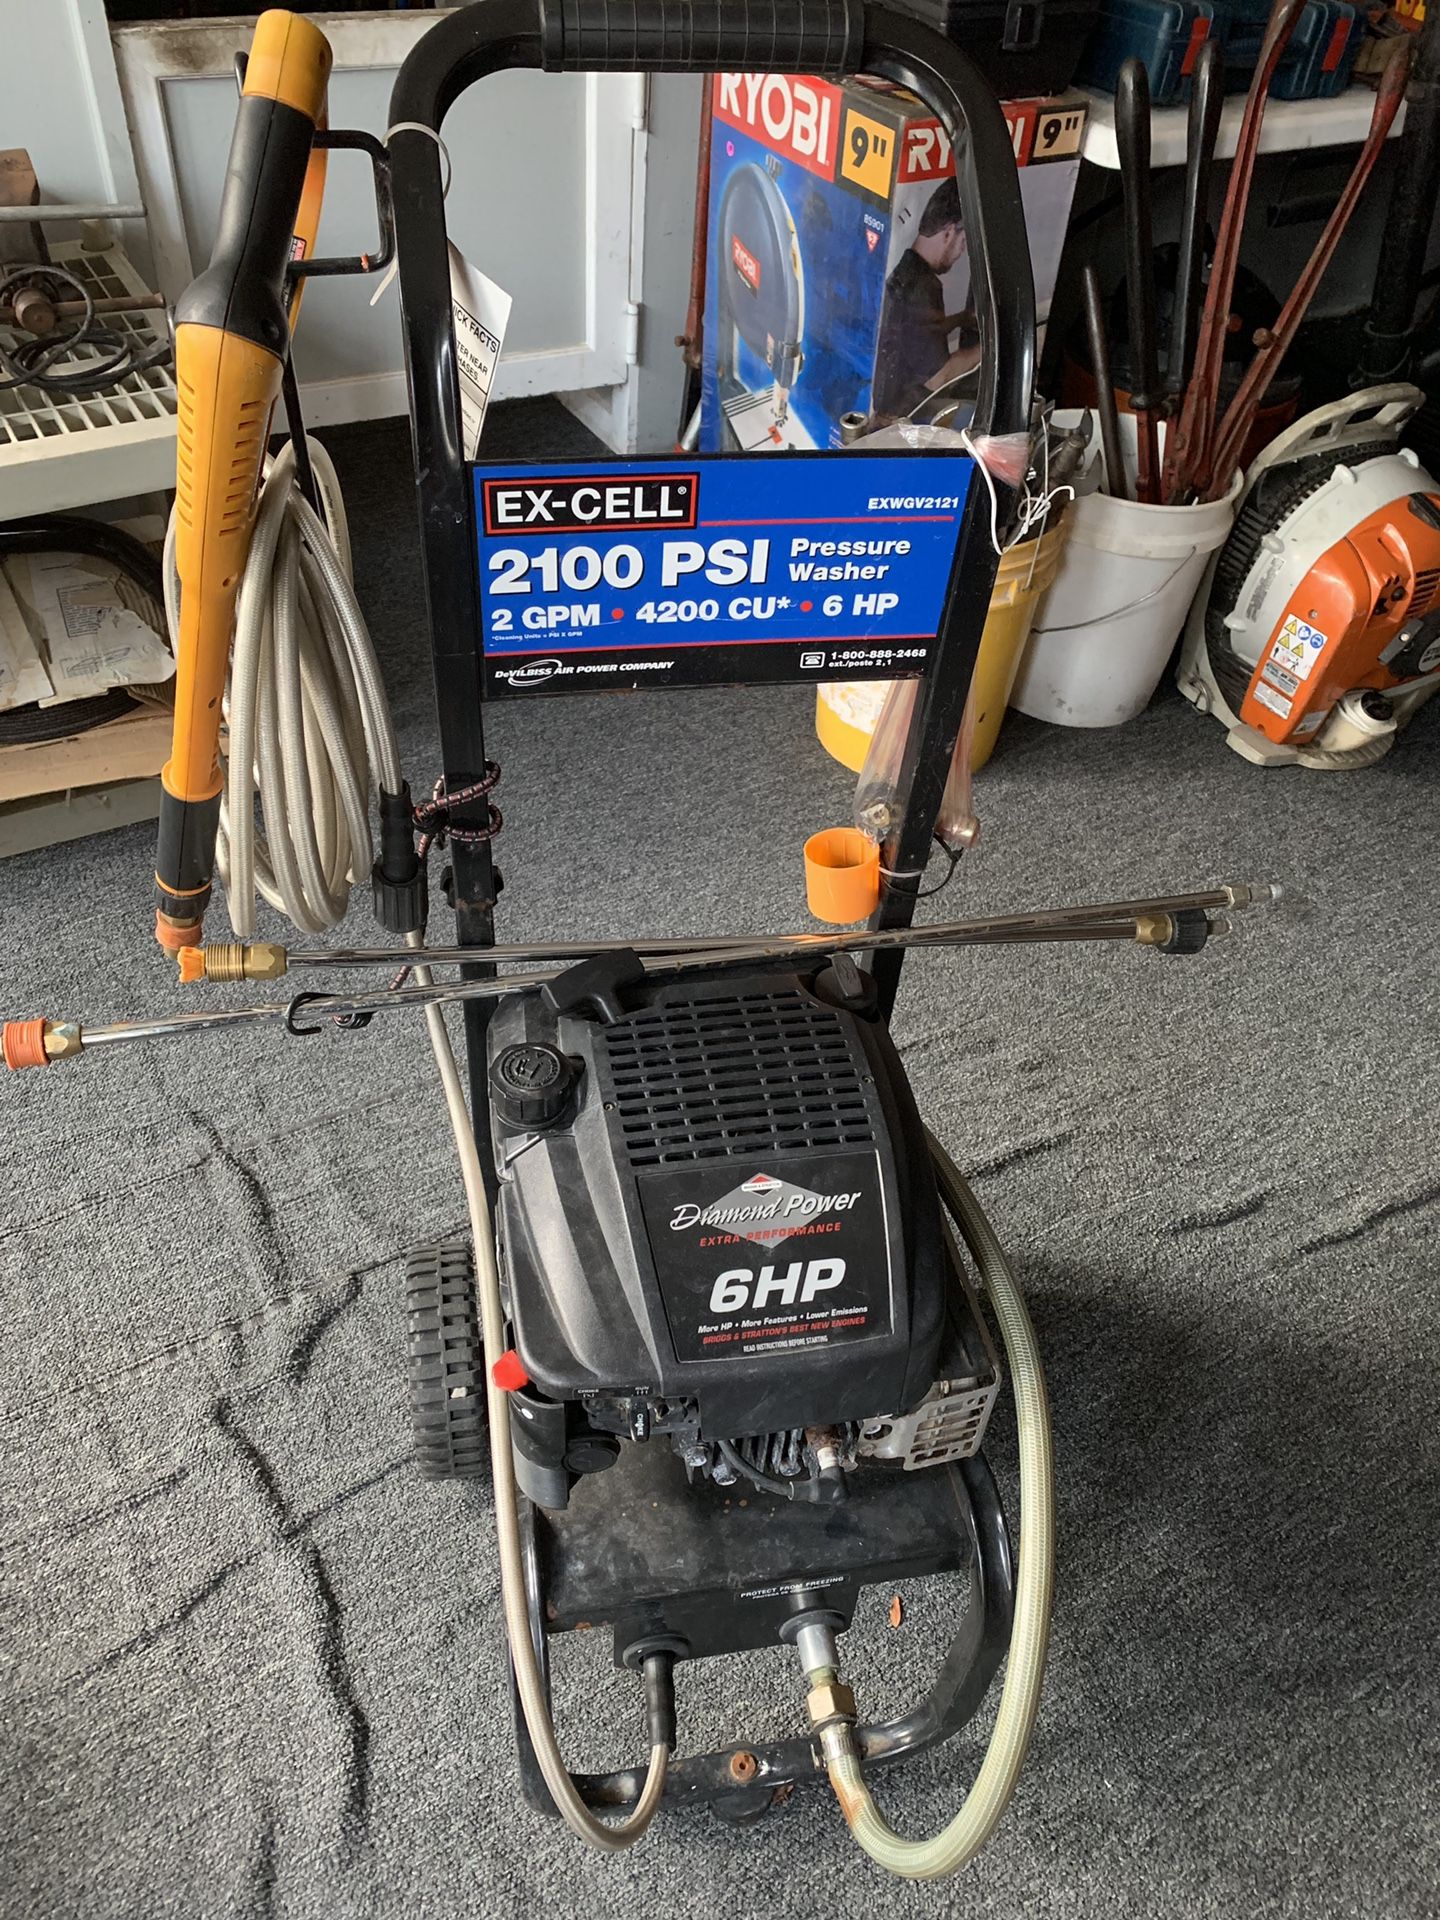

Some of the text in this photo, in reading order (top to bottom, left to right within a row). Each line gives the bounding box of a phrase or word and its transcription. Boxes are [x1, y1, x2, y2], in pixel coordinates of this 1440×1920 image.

[720, 72, 831, 165] RYOBI
[1042, 116, 1079, 149] 9"
[851, 126, 887, 168] 9"
[907, 116, 1026, 173] RYI
[469, 321, 498, 354] FACTS
[470, 353, 489, 377] NEAR
[867, 496, 960, 511] EXWGV2121
[790, 537, 912, 559] Pressure
[488, 538, 770, 595] 2100 PSI
[788, 562, 890, 582] Washer
[491, 608, 515, 632] 2
[521, 602, 601, 631] GPM
[635, 598, 719, 624] 4200
[822, 595, 844, 617] 6
[852, 592, 900, 616] HP
[553, 666, 574, 676] AIR
[576, 664, 618, 674] POWER
[619, 661, 676, 671] COMPANY
[828, 660, 874, 669] ext./poste
[831, 648, 928, 660] 1-800-888-2468
[669, 1191, 863, 1231] Diamond Power
[699, 1221, 842, 1247] EXTRA PERFORMANCE
[709, 1257, 847, 1314] 6HP
[698, 1305, 869, 1334] More HP More Features Lower Emissions
[702, 1333, 732, 1345] BRIGGS
[789, 1323, 809, 1333] BEST
[810, 1320, 830, 1331] NEW
[831, 1315, 866, 1328] ENGINES
[743, 1334, 829, 1352] READ INSTRUCTIONS BEFORE STARTING
[740, 1576, 845, 1598] PROTECT FROM FREEZING
